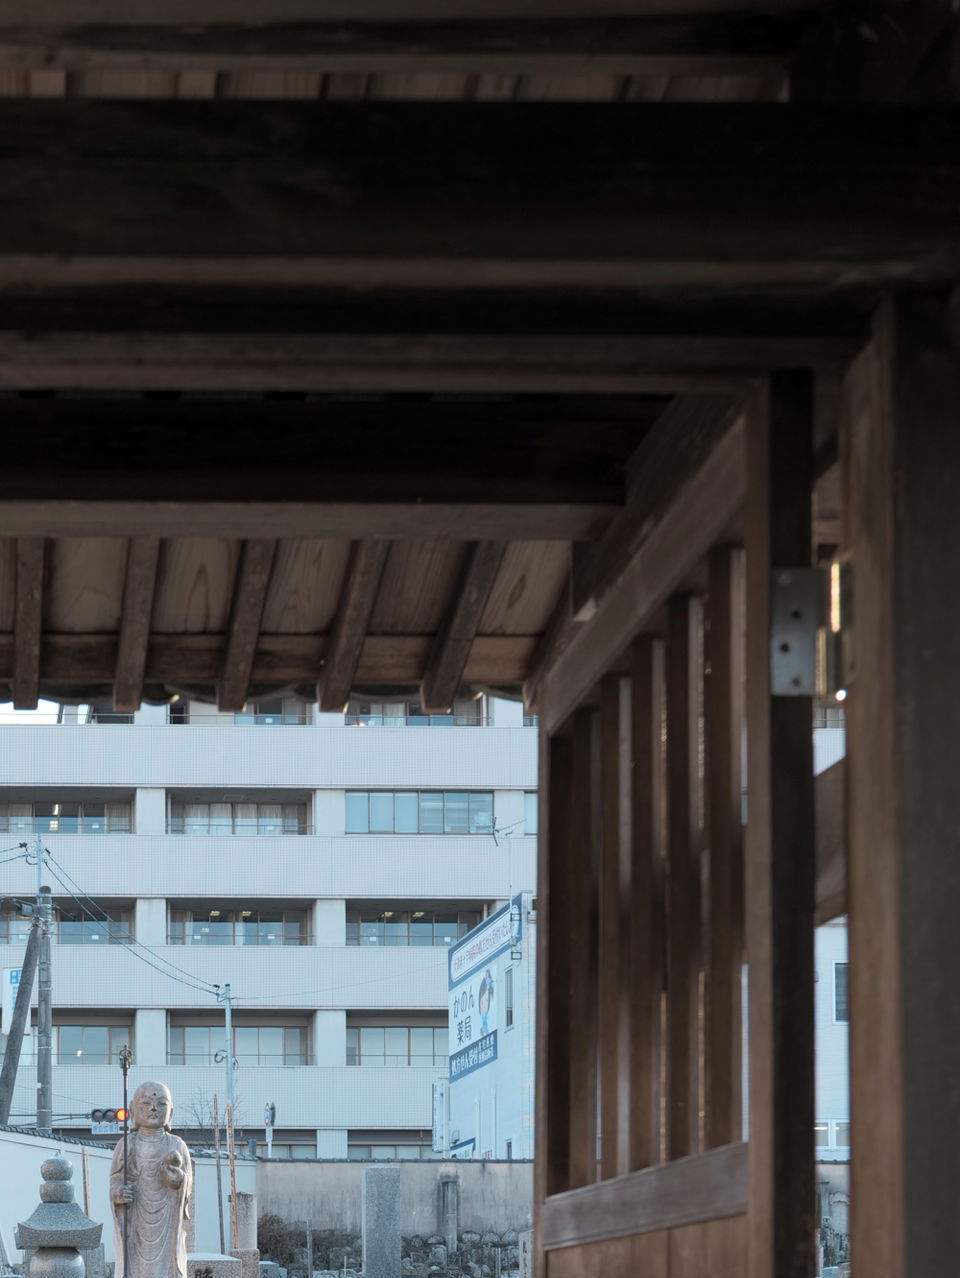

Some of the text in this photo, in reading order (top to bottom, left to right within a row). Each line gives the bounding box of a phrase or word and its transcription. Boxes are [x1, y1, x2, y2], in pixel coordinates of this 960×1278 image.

[453, 984, 474, 1018] かのん
[456, 1015, 472, 1046] 薬局
